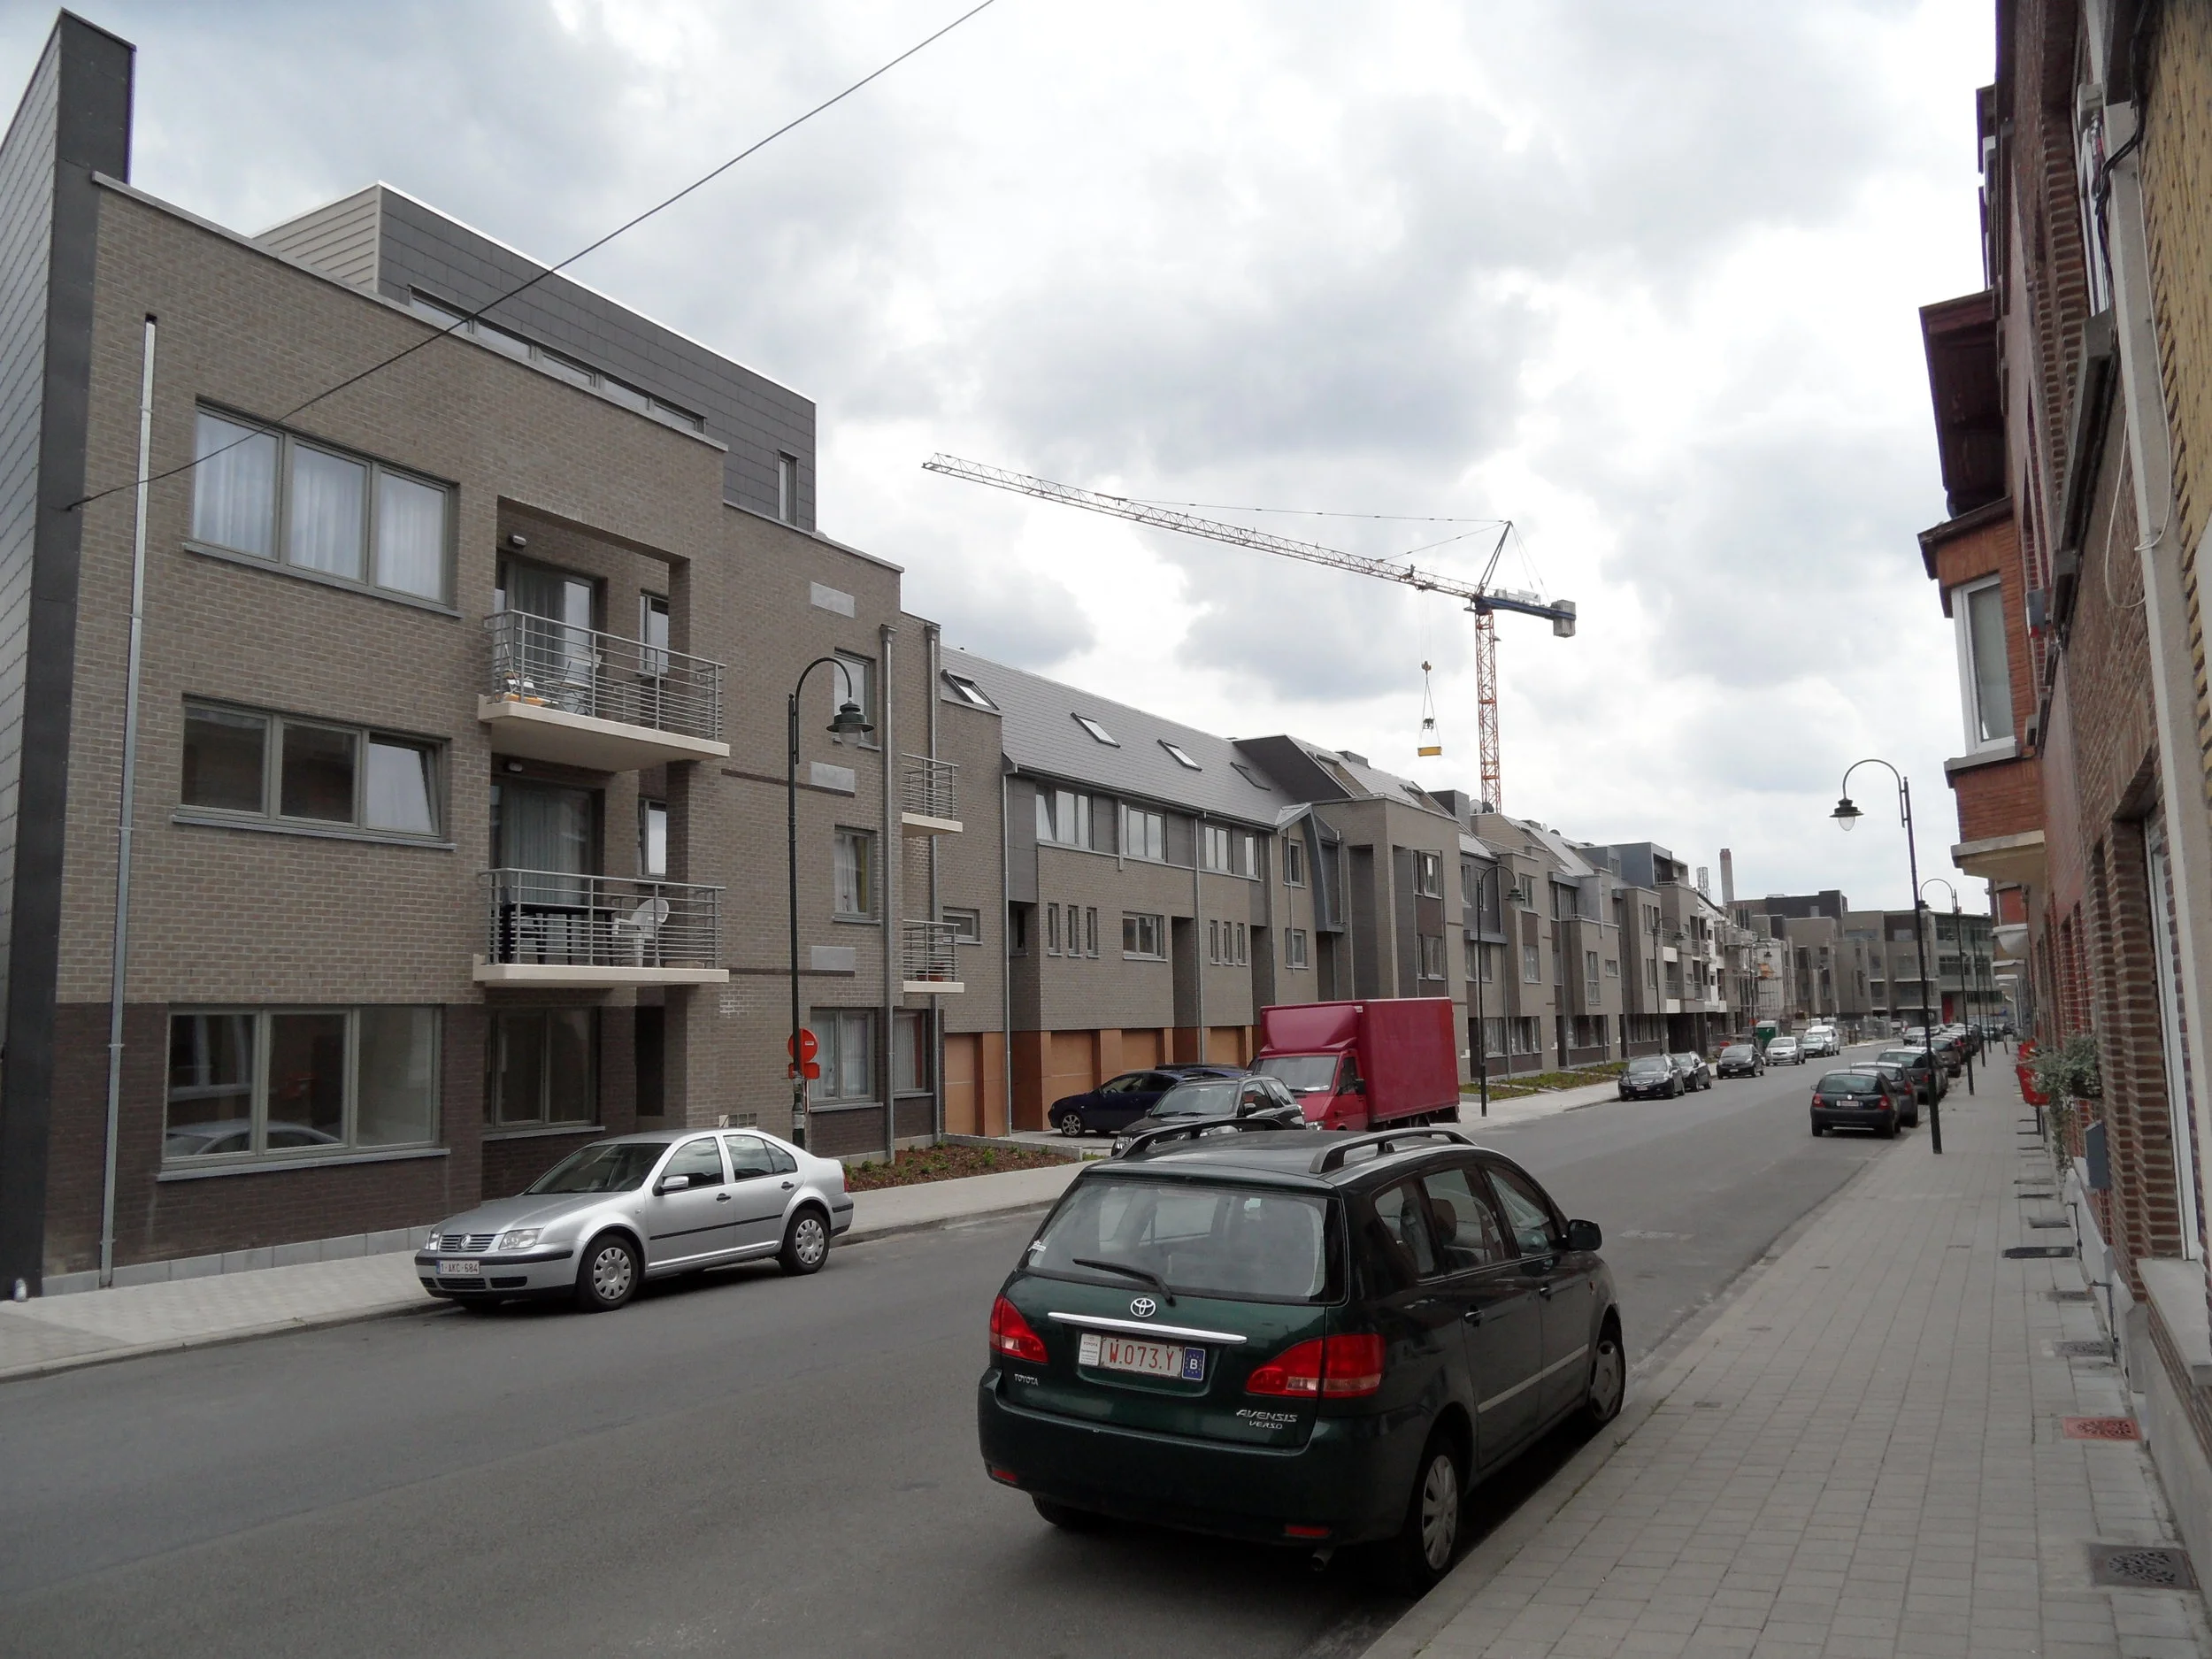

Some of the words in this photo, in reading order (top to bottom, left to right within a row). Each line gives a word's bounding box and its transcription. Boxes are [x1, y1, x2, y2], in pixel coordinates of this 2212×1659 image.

[1189, 1358, 1198, 1370] B
[1014, 1373, 1039, 1386] TOYOTA
[1236, 1409, 1298, 1423] AVENSIS
[1248, 1420, 1283, 1430] VERSO
